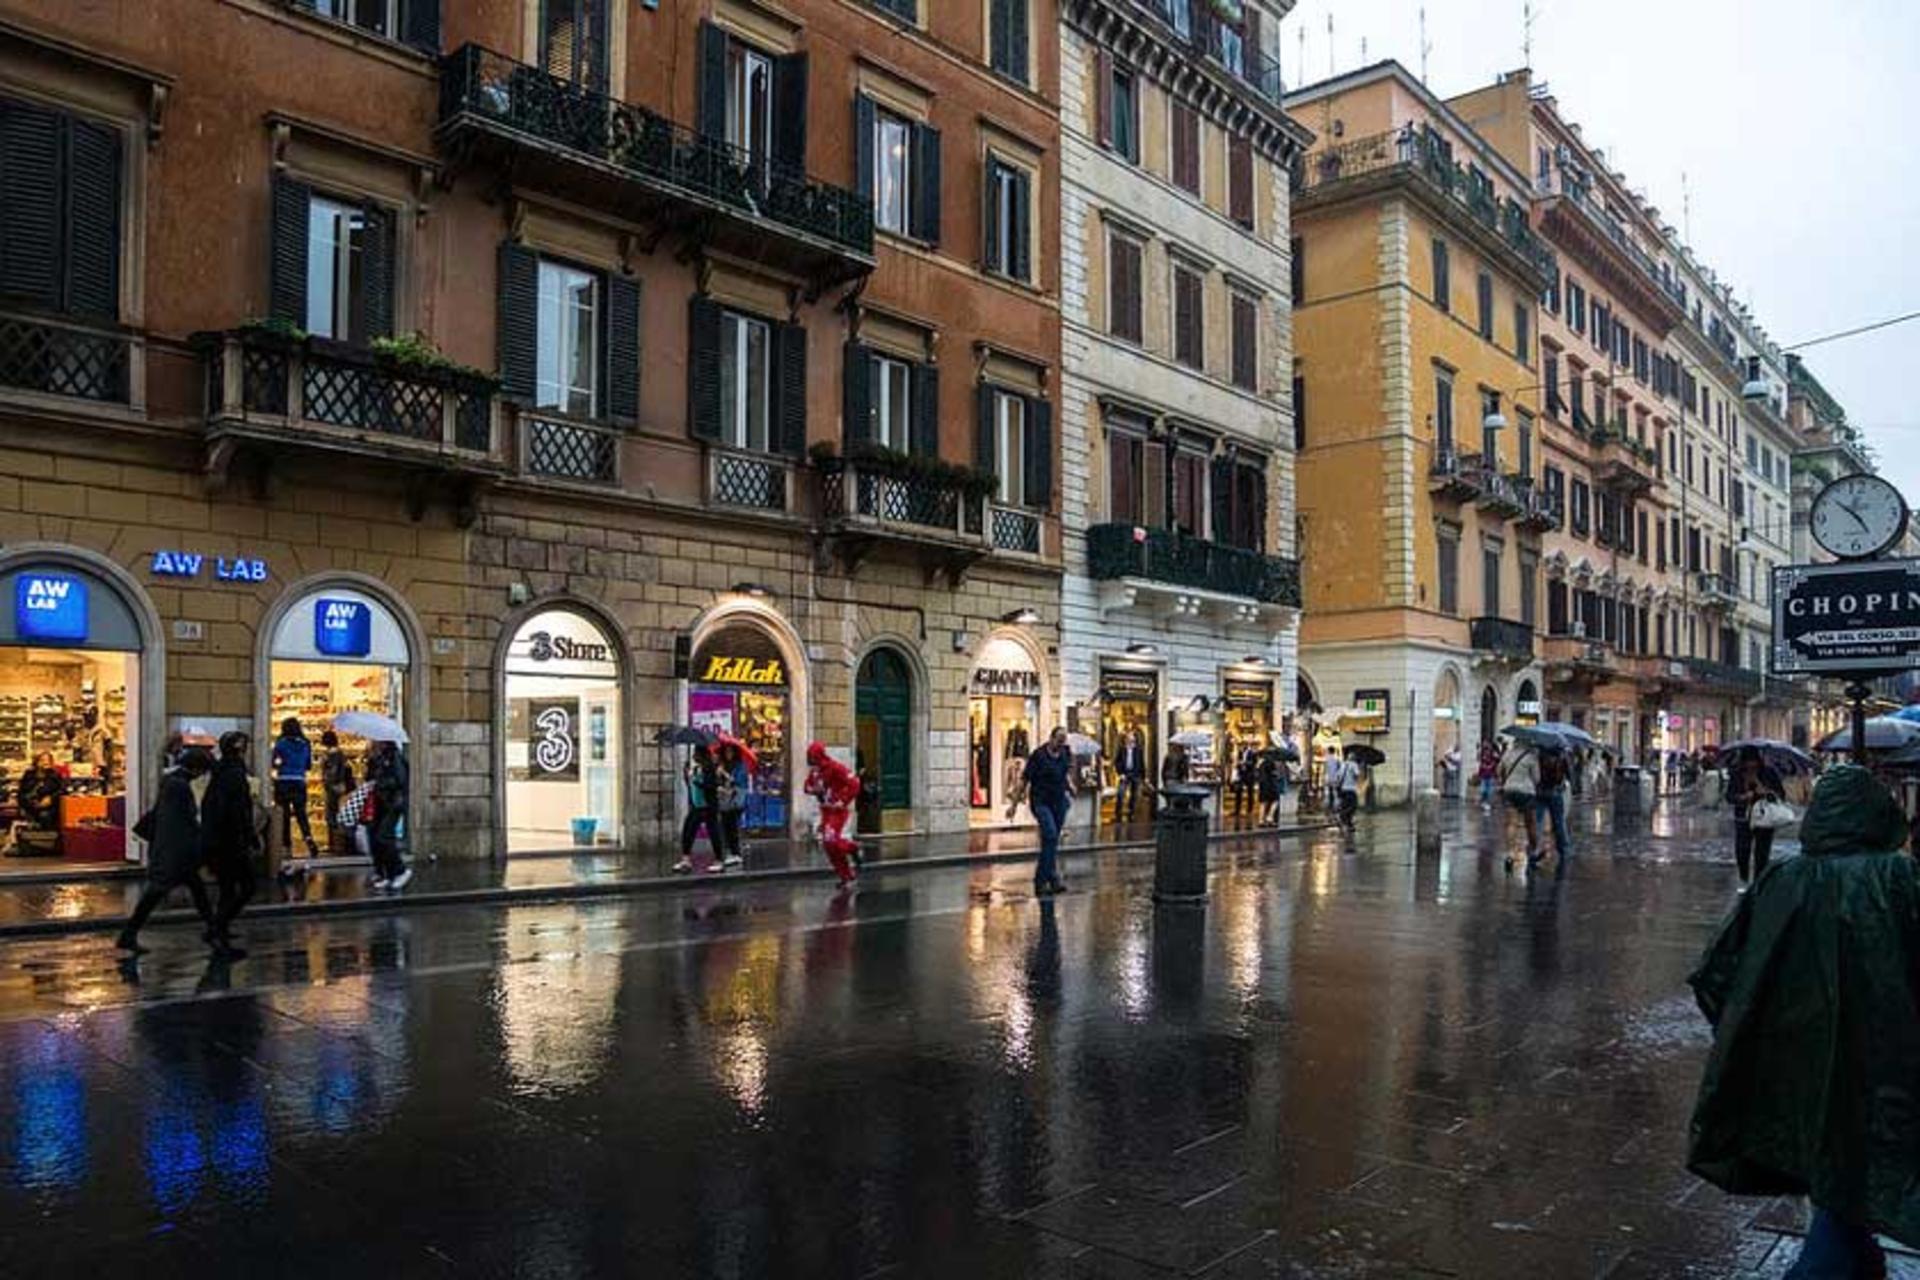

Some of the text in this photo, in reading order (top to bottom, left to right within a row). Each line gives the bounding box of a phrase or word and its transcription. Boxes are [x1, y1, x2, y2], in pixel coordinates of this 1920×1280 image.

[152, 552, 267, 580] AW LAB
[28, 580, 70, 598] AW
[26, 596, 57, 610] LAB
[325, 603, 357, 618] AW
[1789, 591, 1920, 616] CHOPIN
[701, 656, 784, 684] Killah
